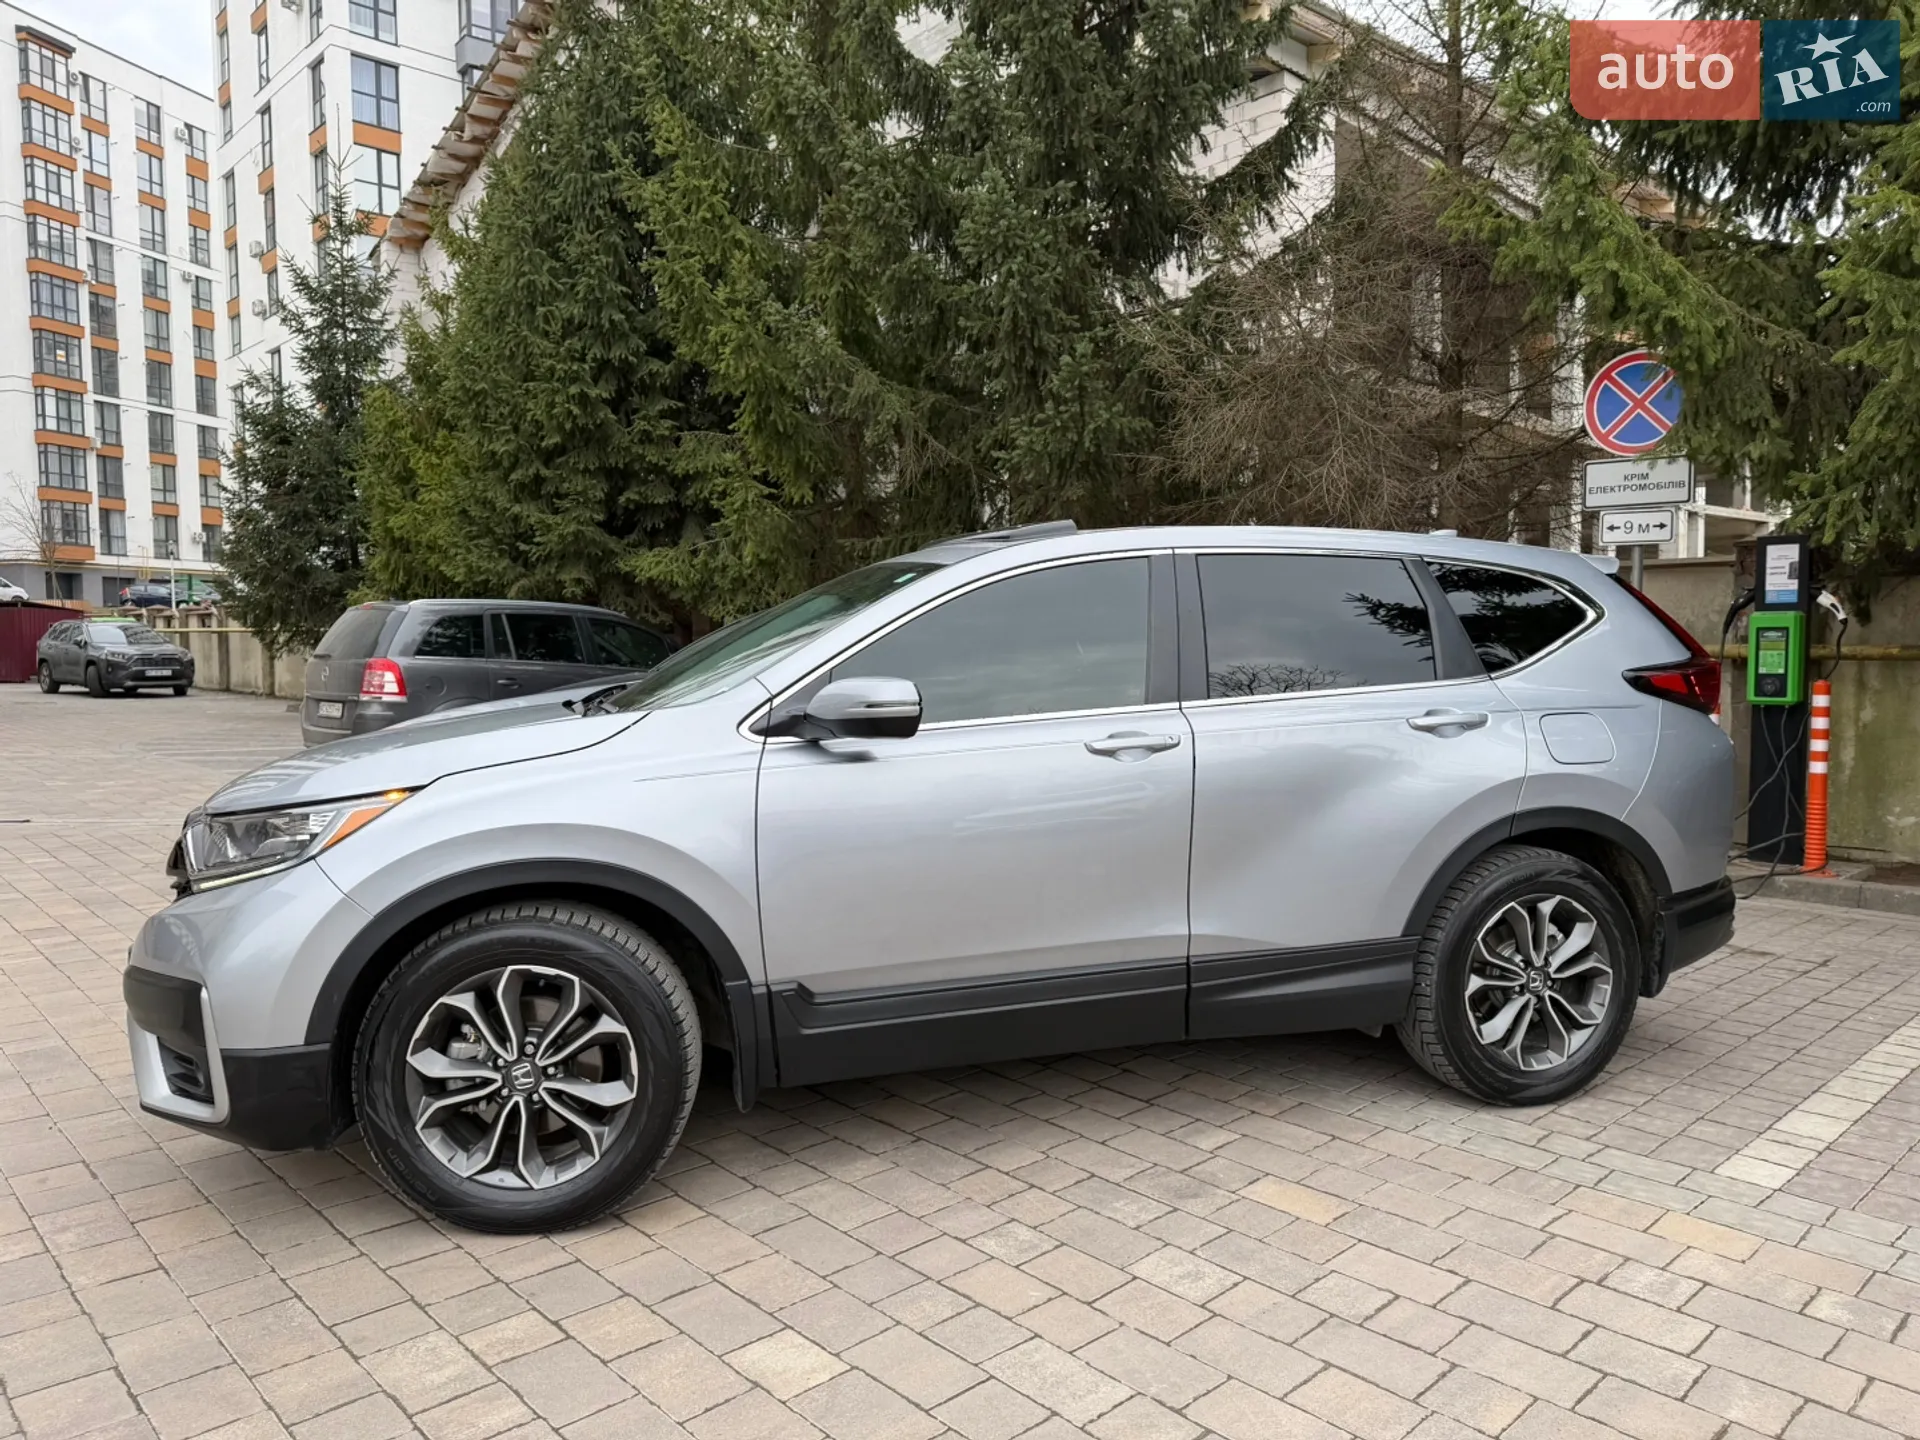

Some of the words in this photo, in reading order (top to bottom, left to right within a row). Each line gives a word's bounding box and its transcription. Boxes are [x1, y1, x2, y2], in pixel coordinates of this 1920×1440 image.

[1623, 472, 1650, 482] КРІМ
[1588, 480, 1686, 495] ЕЛЕКТРОМОБІЛІВ
[1623, 520, 1634, 534] 9
